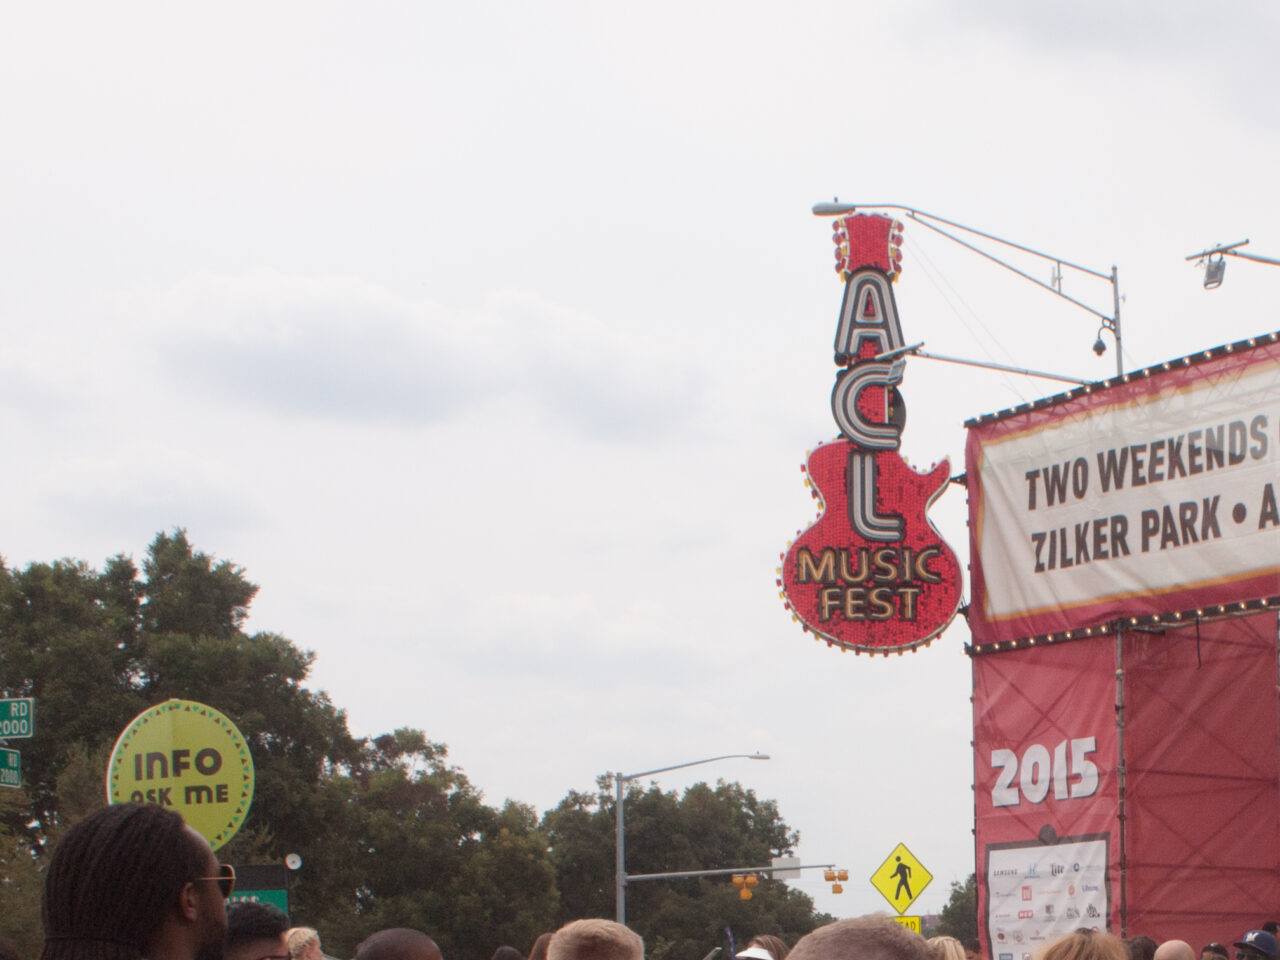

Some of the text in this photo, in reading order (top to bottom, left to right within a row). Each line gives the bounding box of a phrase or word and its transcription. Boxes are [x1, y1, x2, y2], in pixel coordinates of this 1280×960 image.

[831, 267, 906, 542] ACL
[1025, 456, 1089, 511] TWO
[1097, 414, 1269, 493] WEEKENDS
[1031, 514, 1130, 573] ZILKER
[1141, 494, 1221, 552] PARK
[799, 547, 942, 584] MUSIC
[819, 586, 921, 621] FEST
[0, 720, 28, 735] 000
[10, 702, 28, 717] RD
[134, 748, 223, 781] INFO
[990, 736, 1100, 807] 2015
